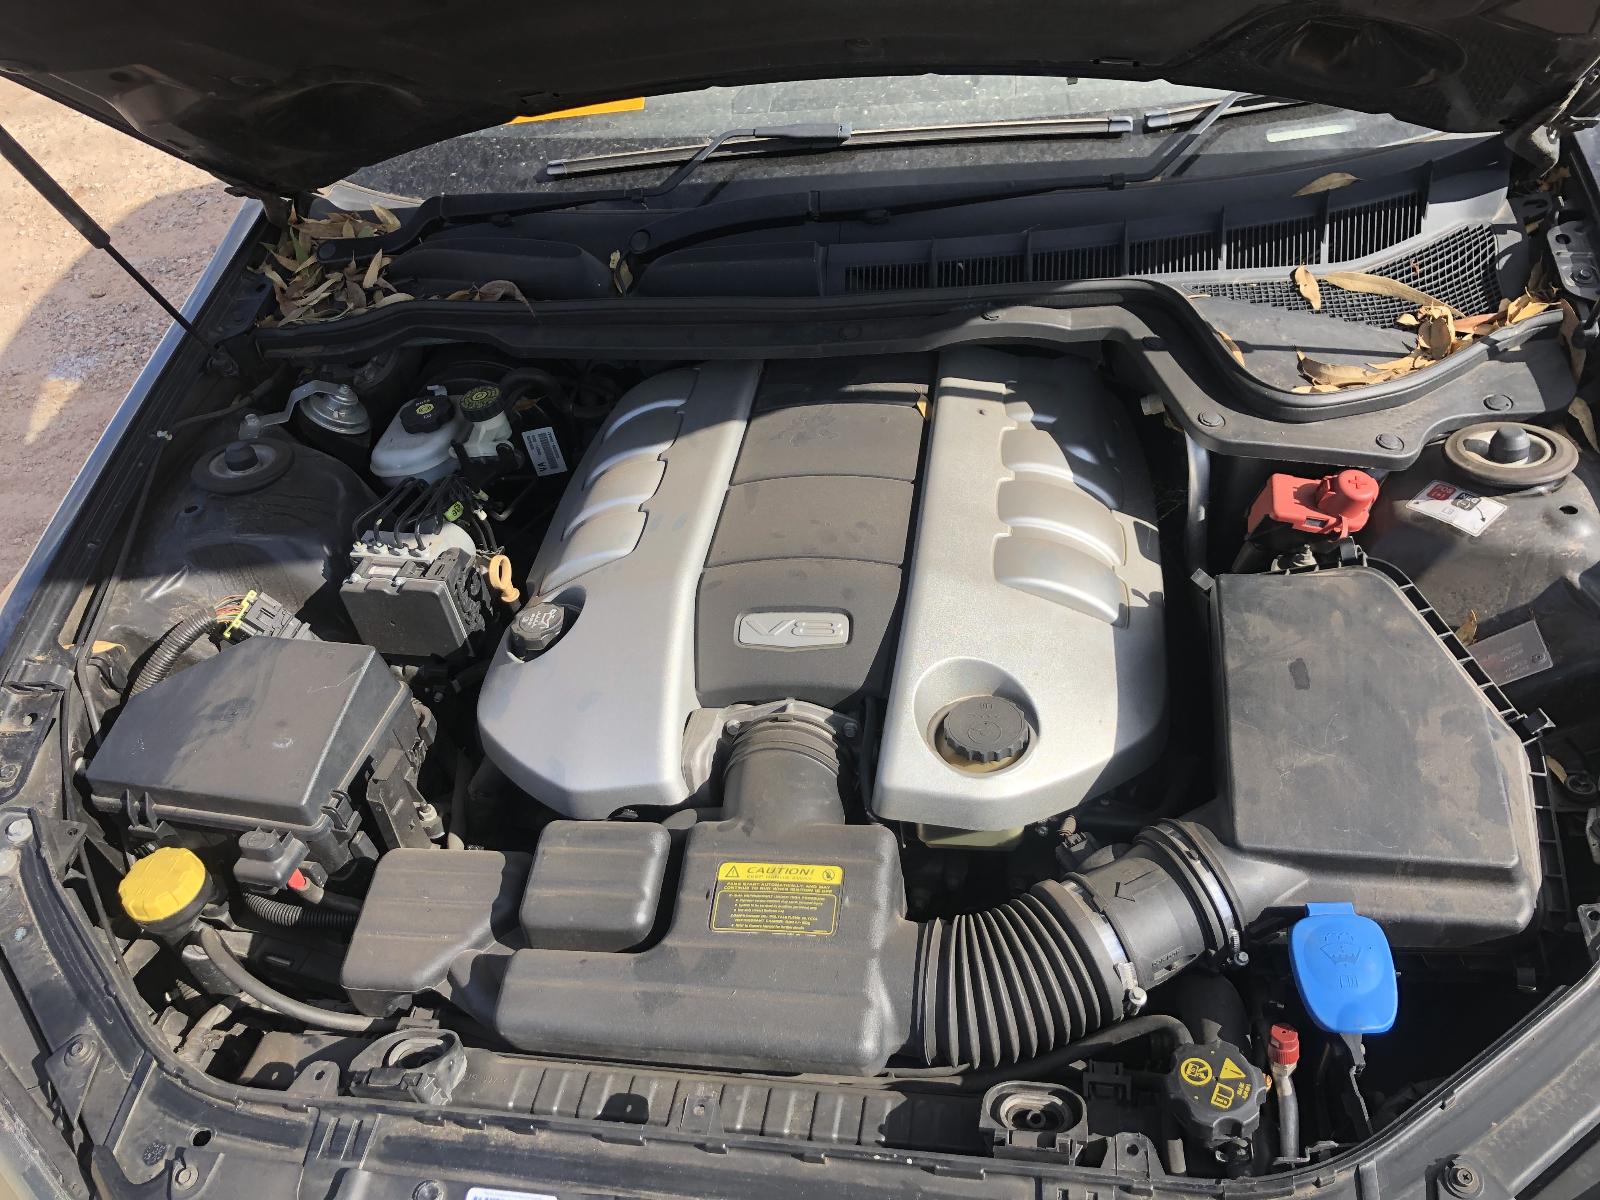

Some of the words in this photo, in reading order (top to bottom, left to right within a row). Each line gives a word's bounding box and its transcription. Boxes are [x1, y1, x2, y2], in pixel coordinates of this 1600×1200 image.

[1460, 493, 1480, 504] NEG
[744, 619, 843, 637] V8
[747, 866, 814, 875] CAUTION!
